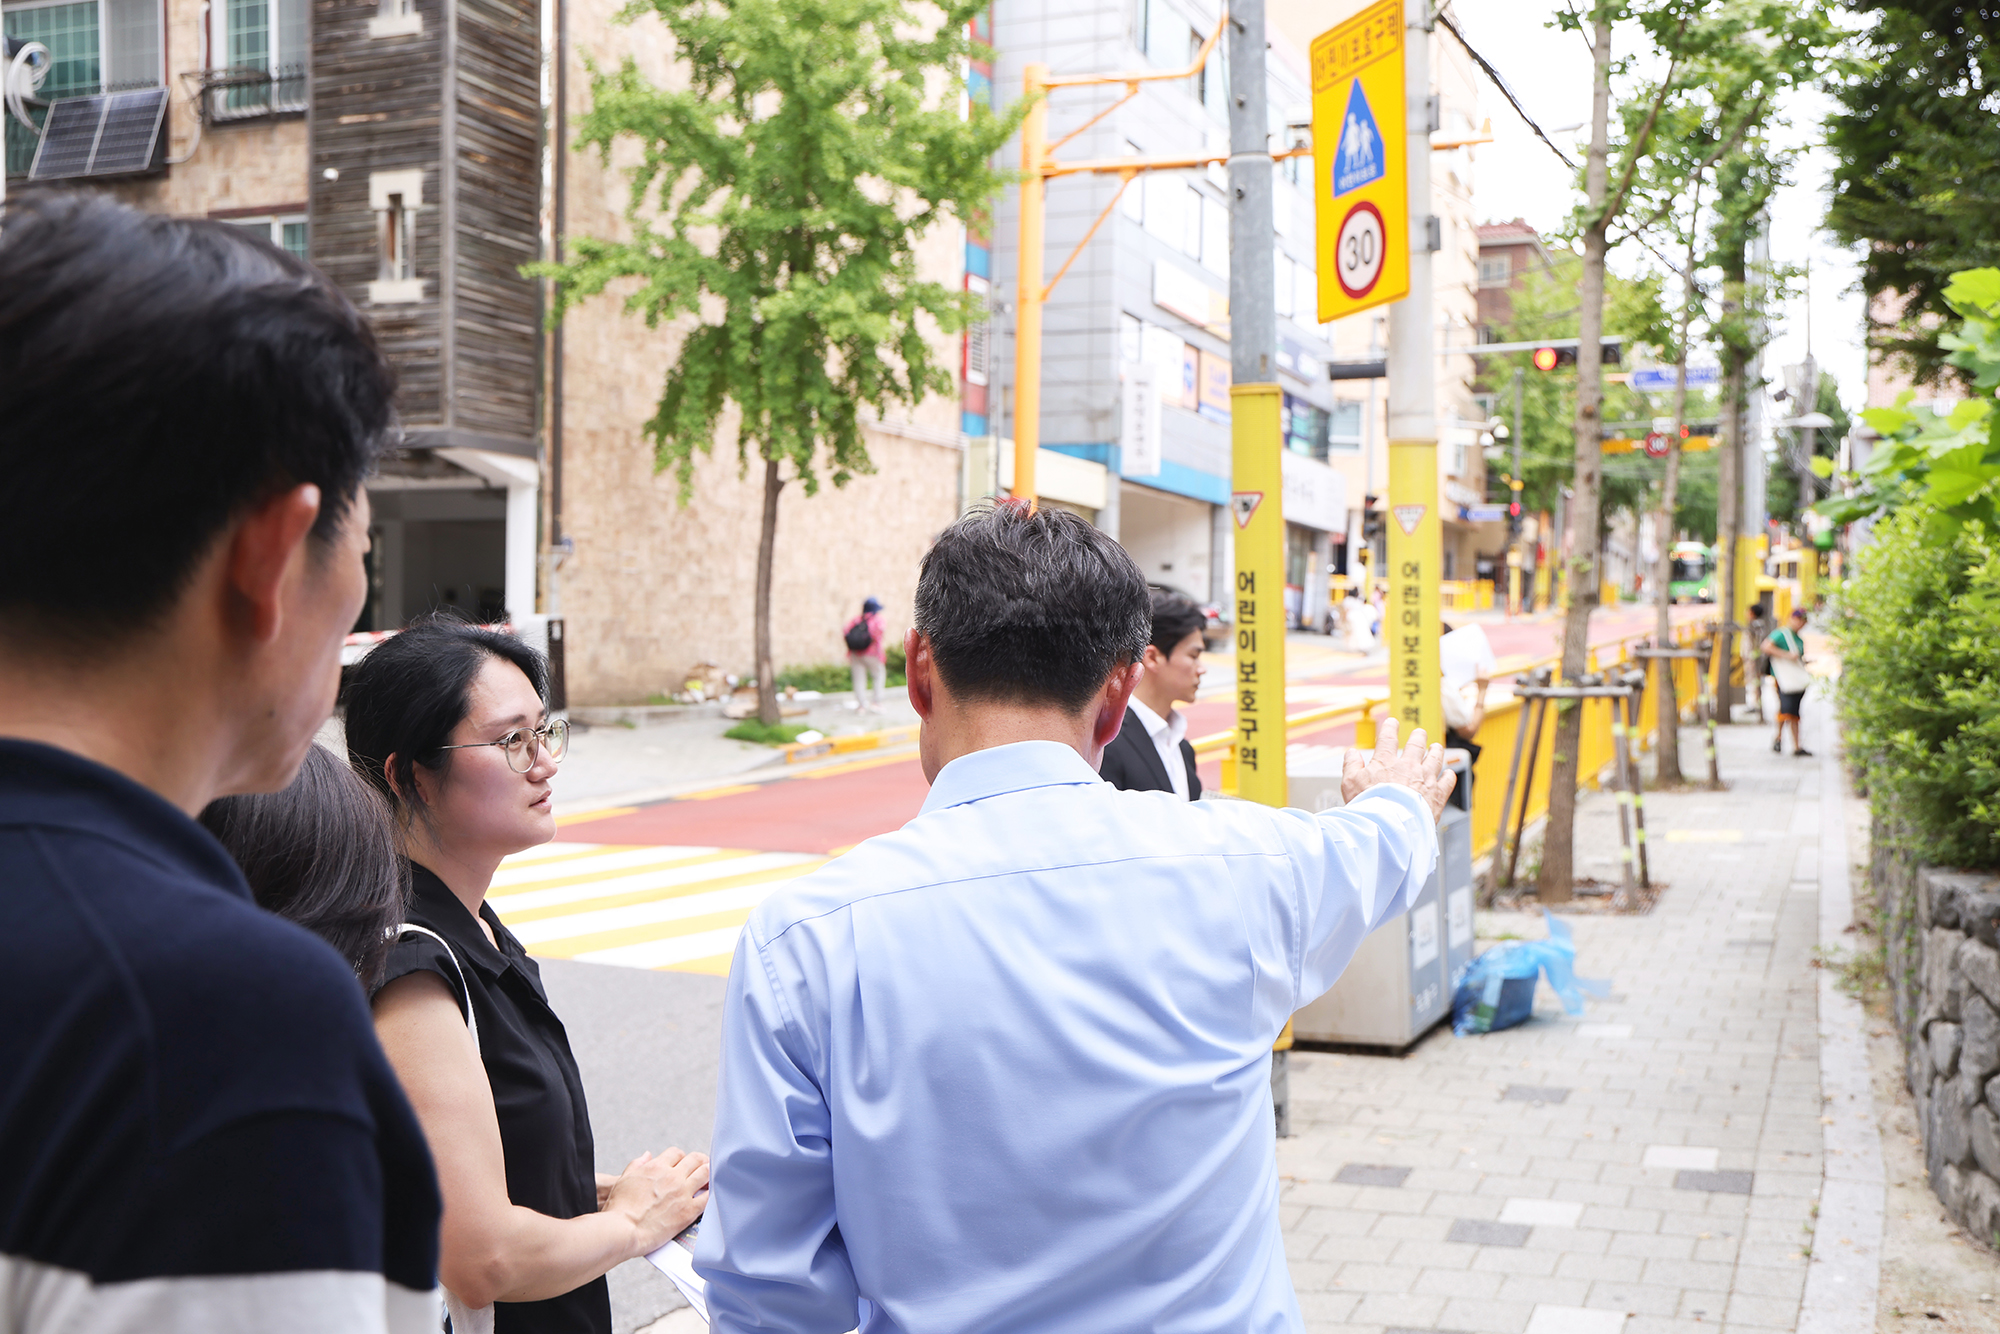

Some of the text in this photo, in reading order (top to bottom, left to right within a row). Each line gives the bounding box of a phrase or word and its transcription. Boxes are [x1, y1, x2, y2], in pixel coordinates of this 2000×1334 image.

[1346, 229, 1374, 271] 30
[1238, 571, 1258, 771] 어린이보호구역
[1402, 562, 1421, 726] 어린이보호구역
